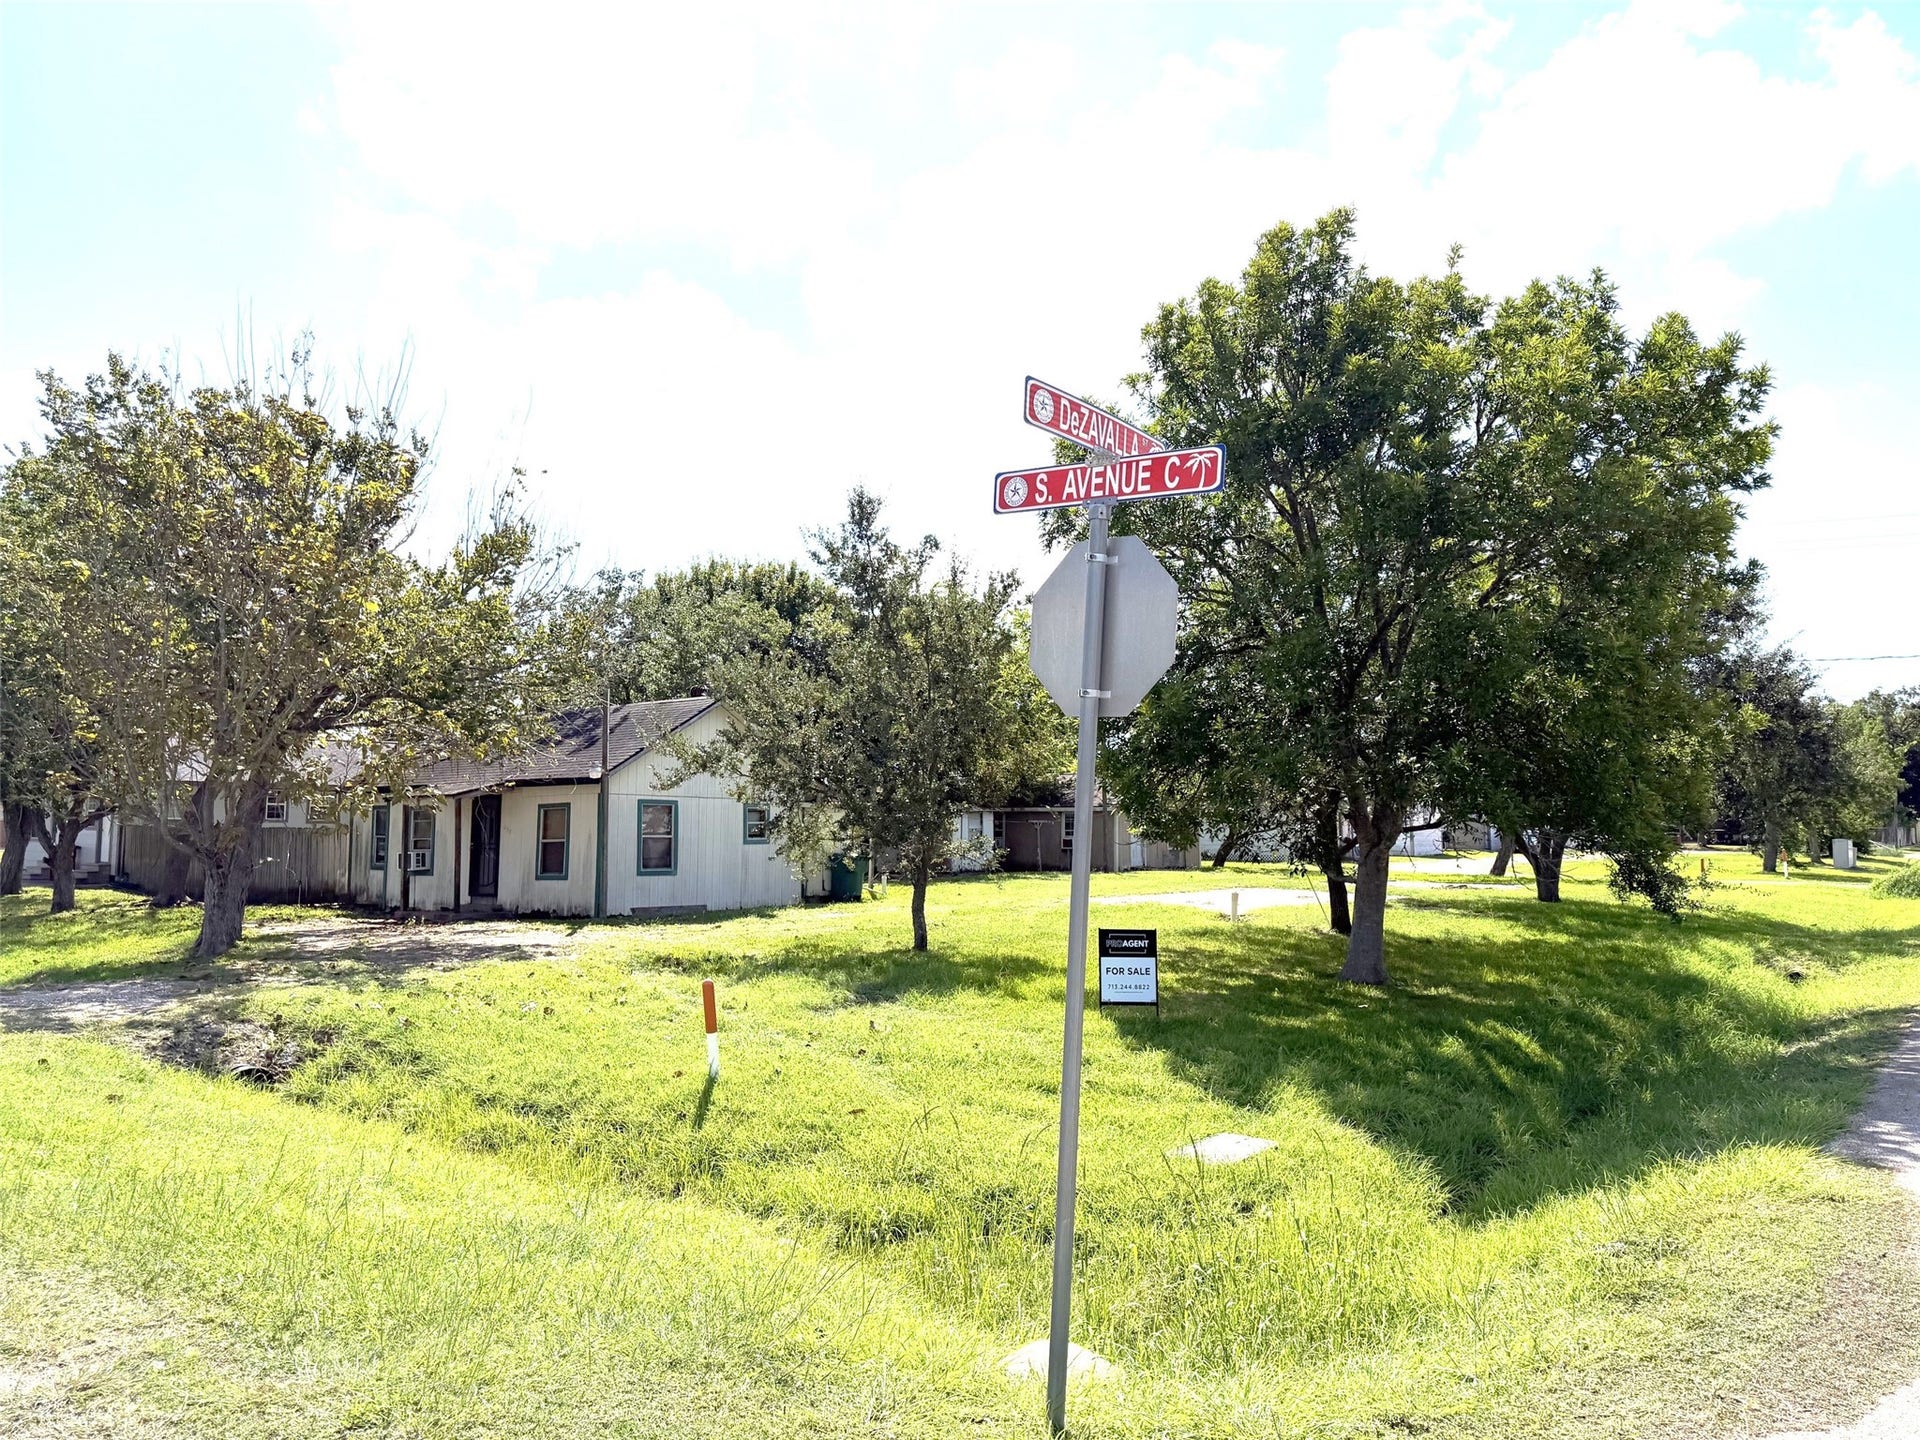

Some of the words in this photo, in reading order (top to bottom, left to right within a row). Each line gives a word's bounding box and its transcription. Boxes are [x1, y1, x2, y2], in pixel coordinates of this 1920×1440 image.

[1060, 397, 1138, 457] DeZAVALLA
[1035, 473, 1052, 504] S.
[1062, 459, 1151, 501] AVENUE
[1164, 456, 1181, 489] C
[1105, 967, 1125, 976] FOR
[1127, 967, 1151, 976] SALE
